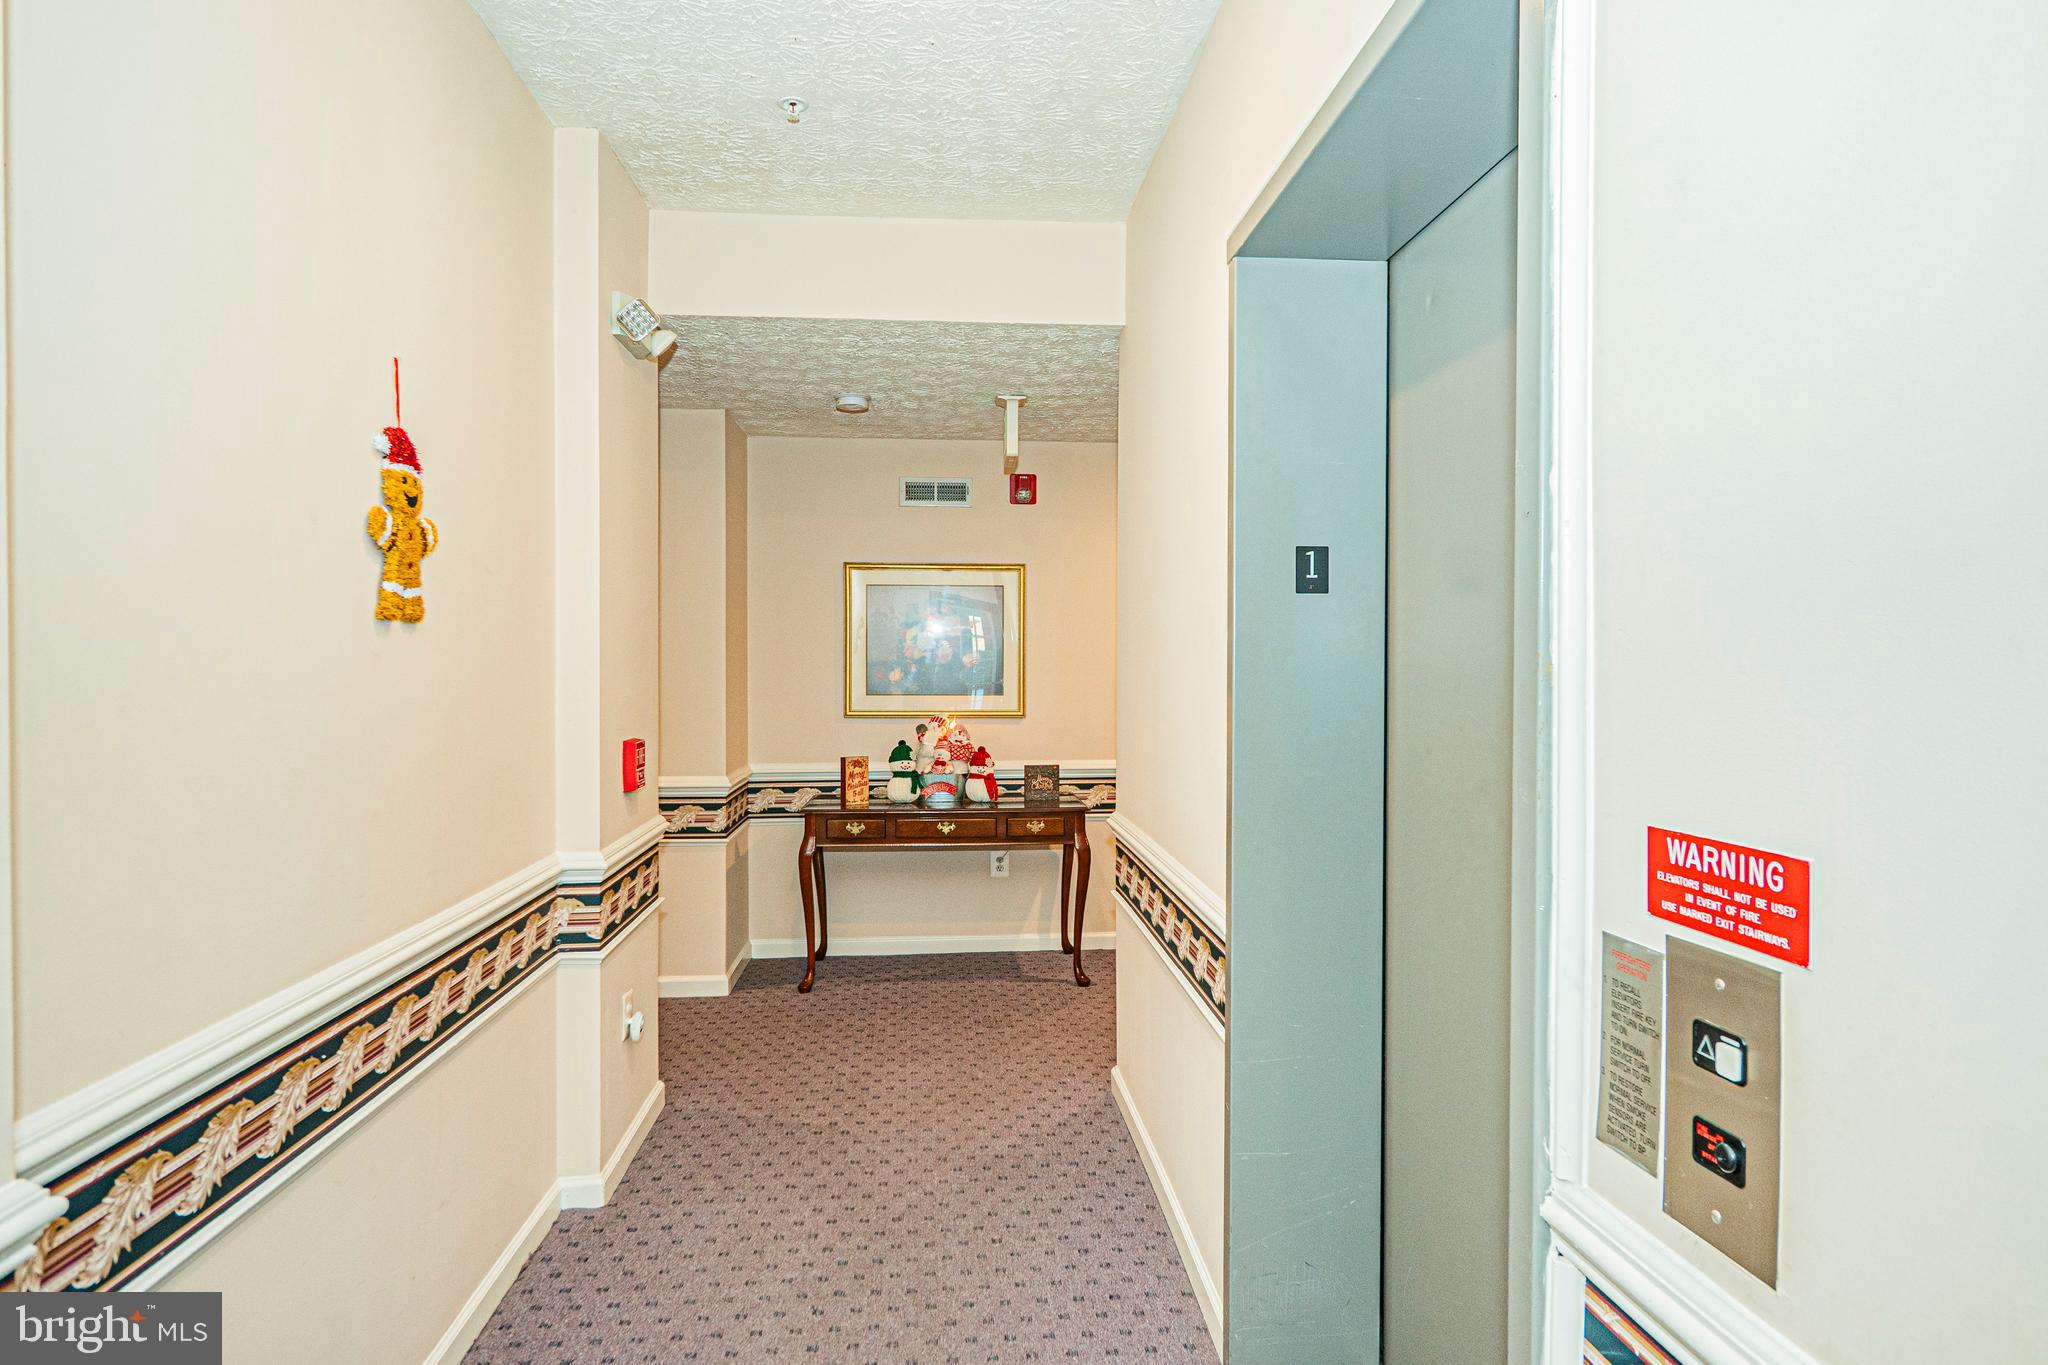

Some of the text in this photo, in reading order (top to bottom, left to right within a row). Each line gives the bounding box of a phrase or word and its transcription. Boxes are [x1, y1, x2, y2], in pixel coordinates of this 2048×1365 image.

[1305, 551, 1318, 579] 1
[1666, 837, 1785, 892] WARNING
[1656, 870, 1798, 919] ELEVATORS SHALL NOT BE USED
[1685, 893, 1695, 903] IN
[1696, 896, 1722, 911] EVENT
[1725, 905, 1737, 916] OF
[1661, 899, 1677, 913] USE
[1679, 906, 1713, 924] MARKED
[1715, 918, 1735, 931] EXIT
